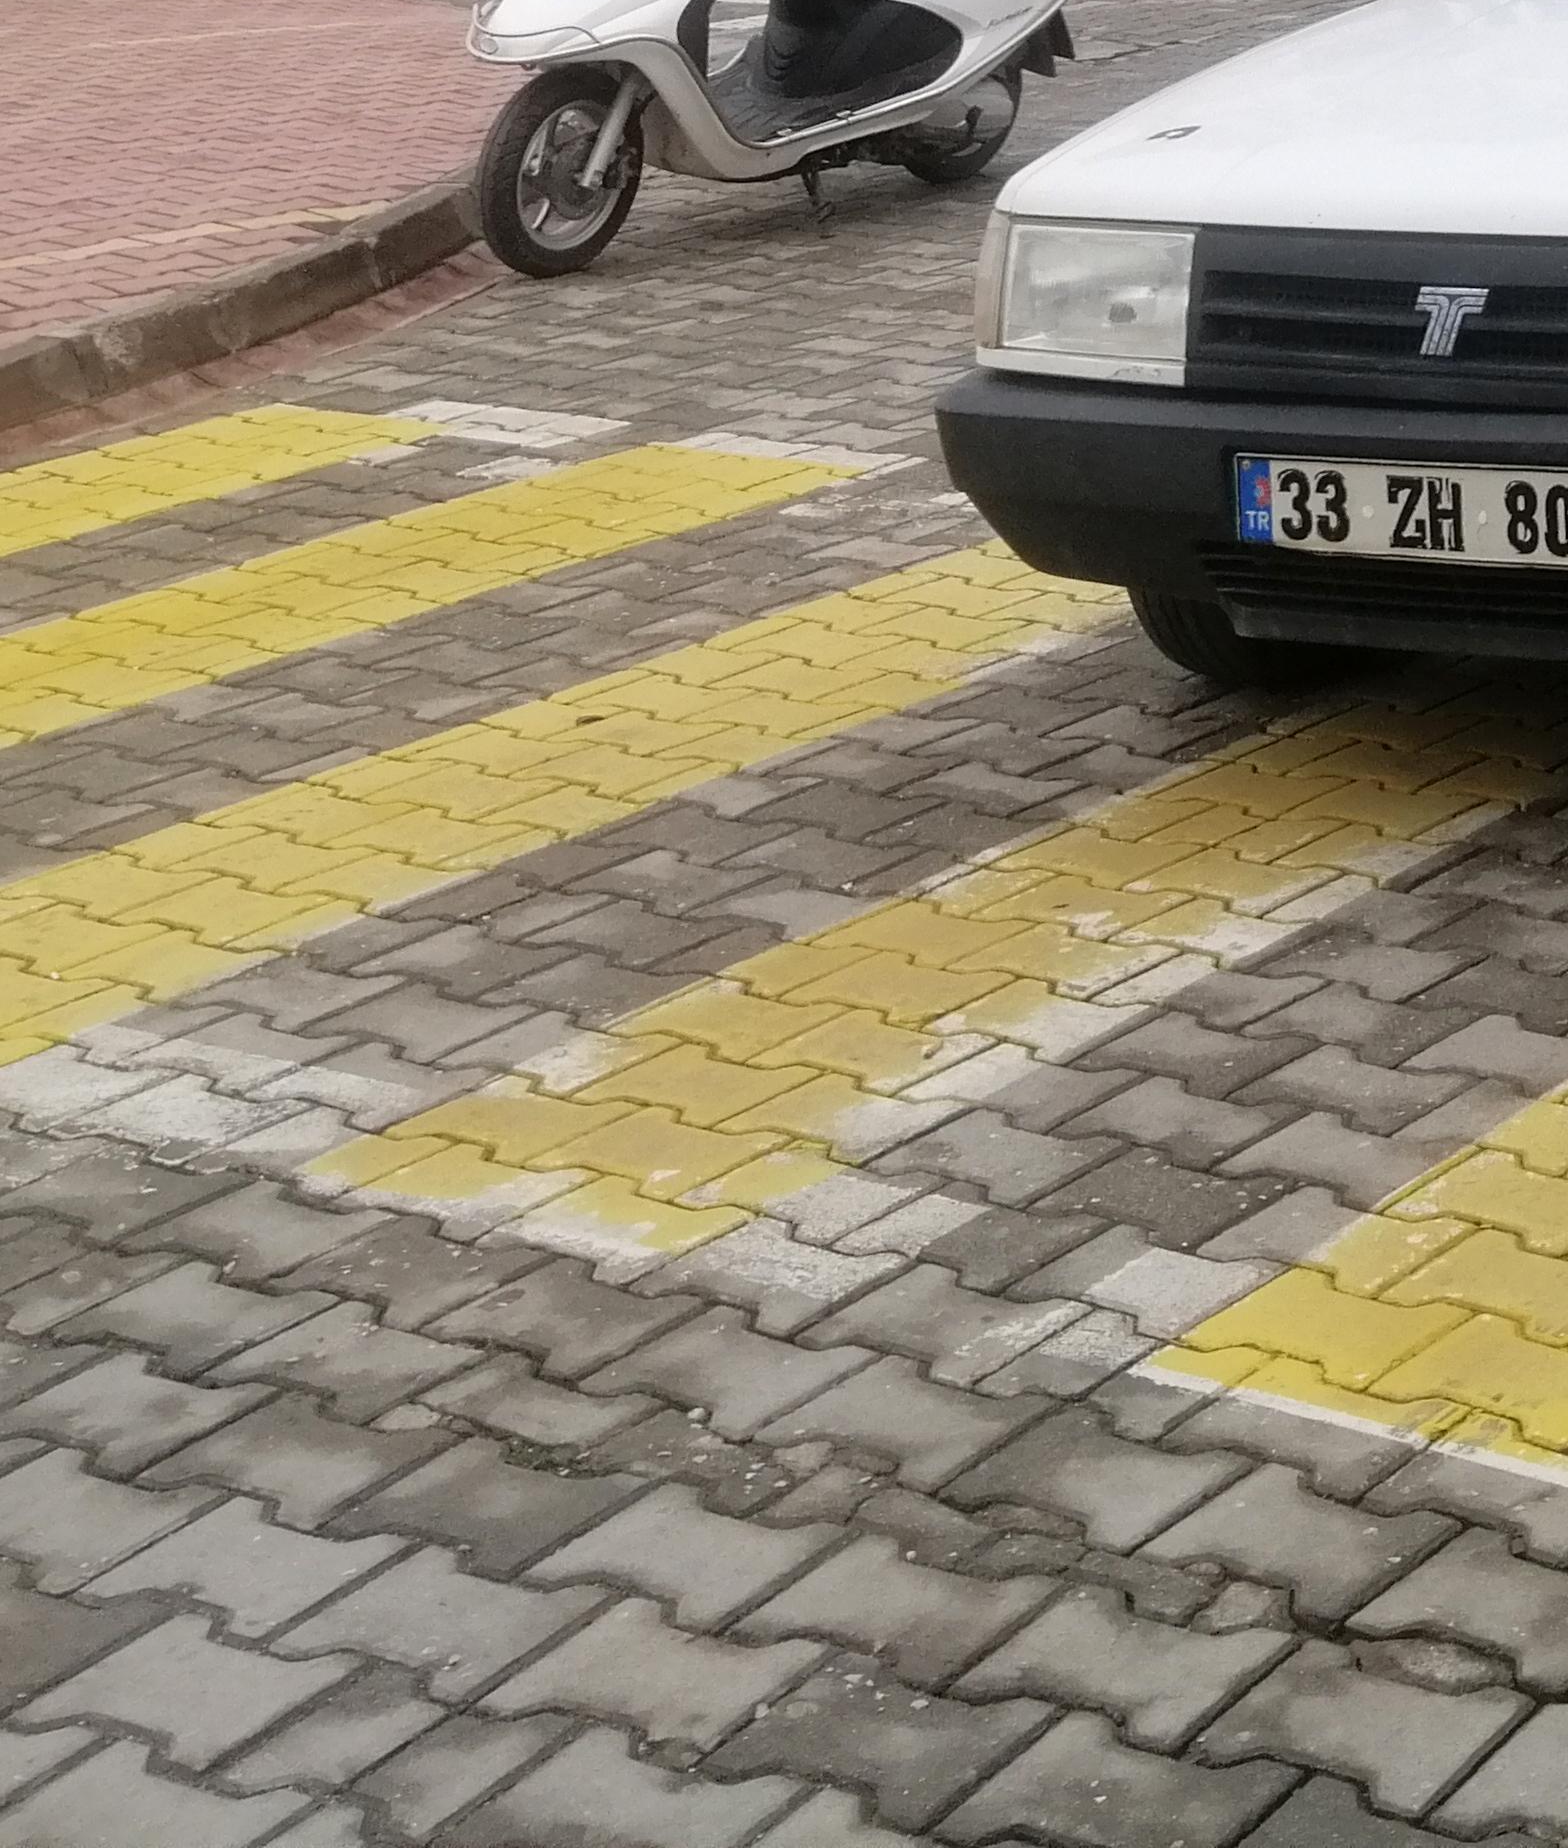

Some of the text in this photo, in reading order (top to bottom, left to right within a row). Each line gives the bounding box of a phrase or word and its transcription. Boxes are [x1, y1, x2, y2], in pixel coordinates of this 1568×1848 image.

[1245, 510, 1270, 531] TR
[1277, 468, 1351, 542] 33
[1387, 475, 1466, 552] ZH
